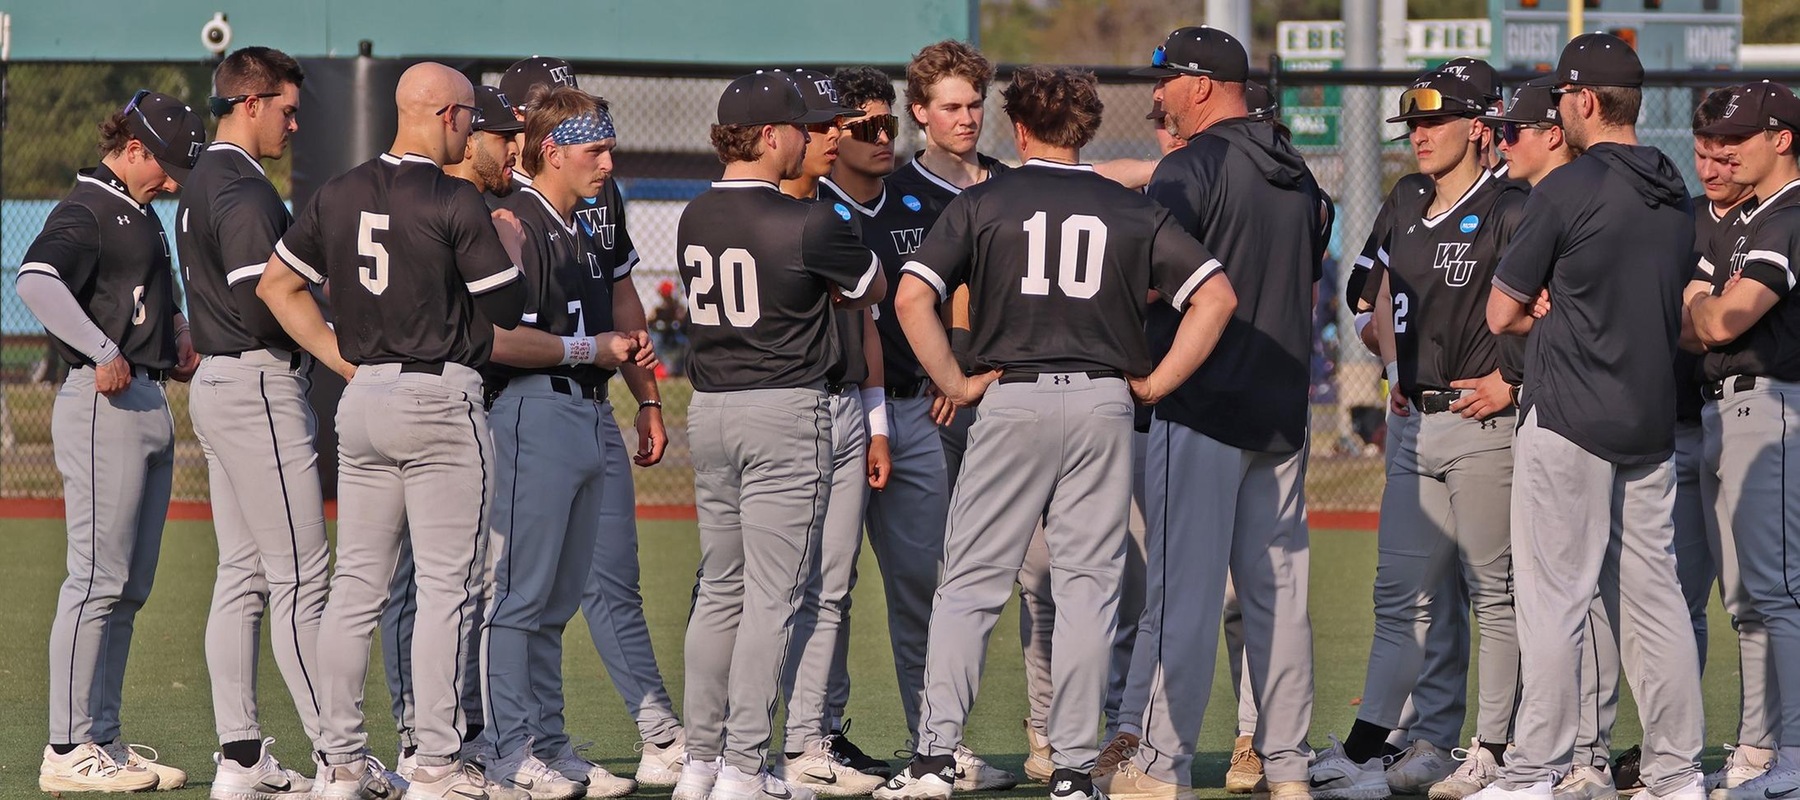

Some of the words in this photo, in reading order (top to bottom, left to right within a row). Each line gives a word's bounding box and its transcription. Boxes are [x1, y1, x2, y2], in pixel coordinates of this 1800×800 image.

[1425, 27, 1491, 48] FIEL
[1508, 24, 1560, 58] GUEST
[1684, 26, 1737, 60] HOME
[358, 211, 389, 295] 5
[1020, 211, 1108, 299] 10
[1433, 242, 1477, 287] WU
[683, 244, 761, 328] 20
[567, 300, 586, 337] 7
[1055, 780, 1072, 793] NB
